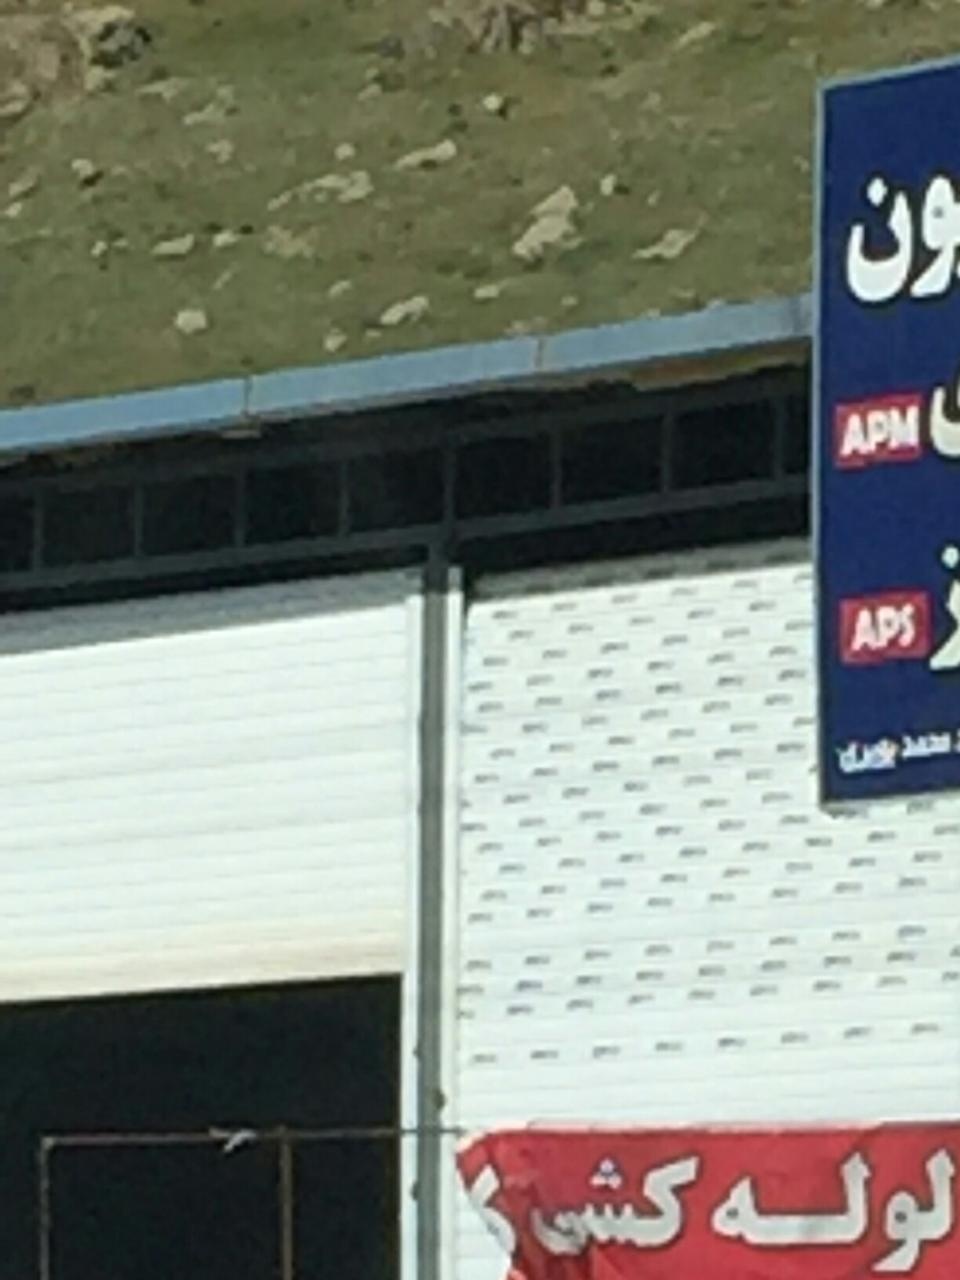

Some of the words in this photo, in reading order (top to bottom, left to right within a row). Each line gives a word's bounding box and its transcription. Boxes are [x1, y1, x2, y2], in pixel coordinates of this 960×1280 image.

[840, 406, 920, 457] APM
[851, 602, 917, 653] APS
[531, 1157, 700, 1256] کشی
[711, 1147, 956, 1273] لوله
